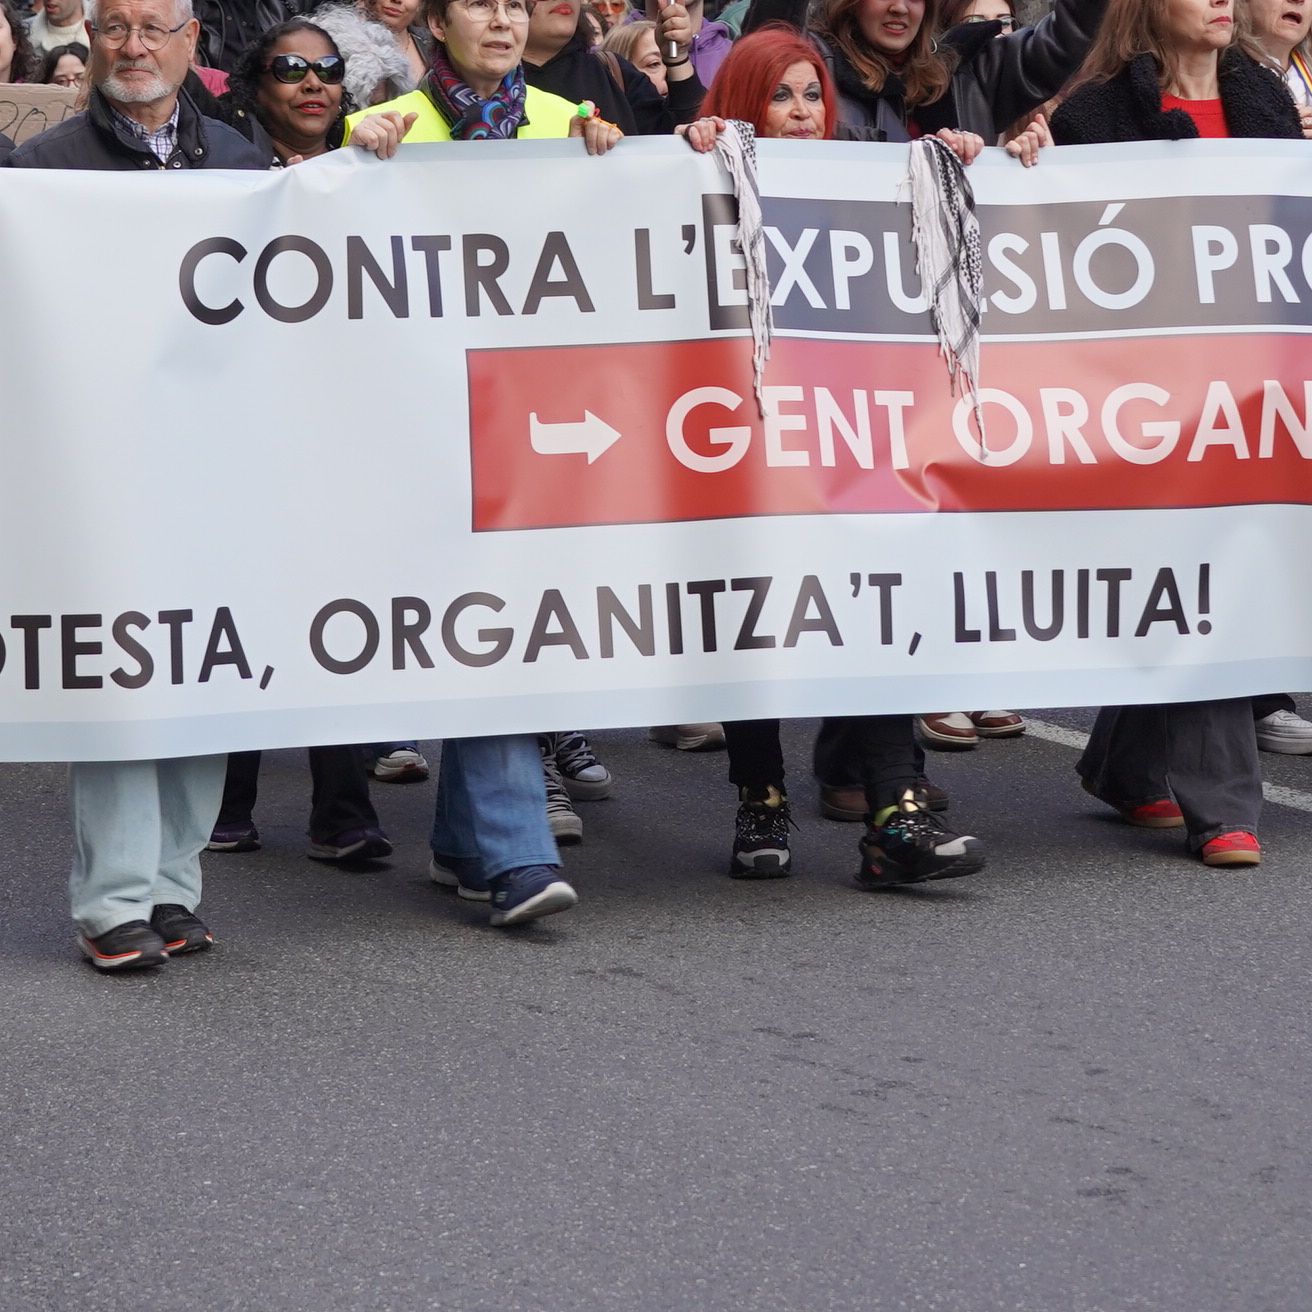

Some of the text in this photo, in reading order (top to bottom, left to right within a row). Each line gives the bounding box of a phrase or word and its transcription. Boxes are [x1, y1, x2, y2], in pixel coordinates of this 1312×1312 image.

[179, 229, 596, 326] CONTRA
[634, 203, 1155, 314] L'EXPUSIÓ
[665, 386, 917, 474] GENT
[309, 569, 922, 670] ORGANITZA'T,
[954, 563, 1215, 645] LLUITA!
